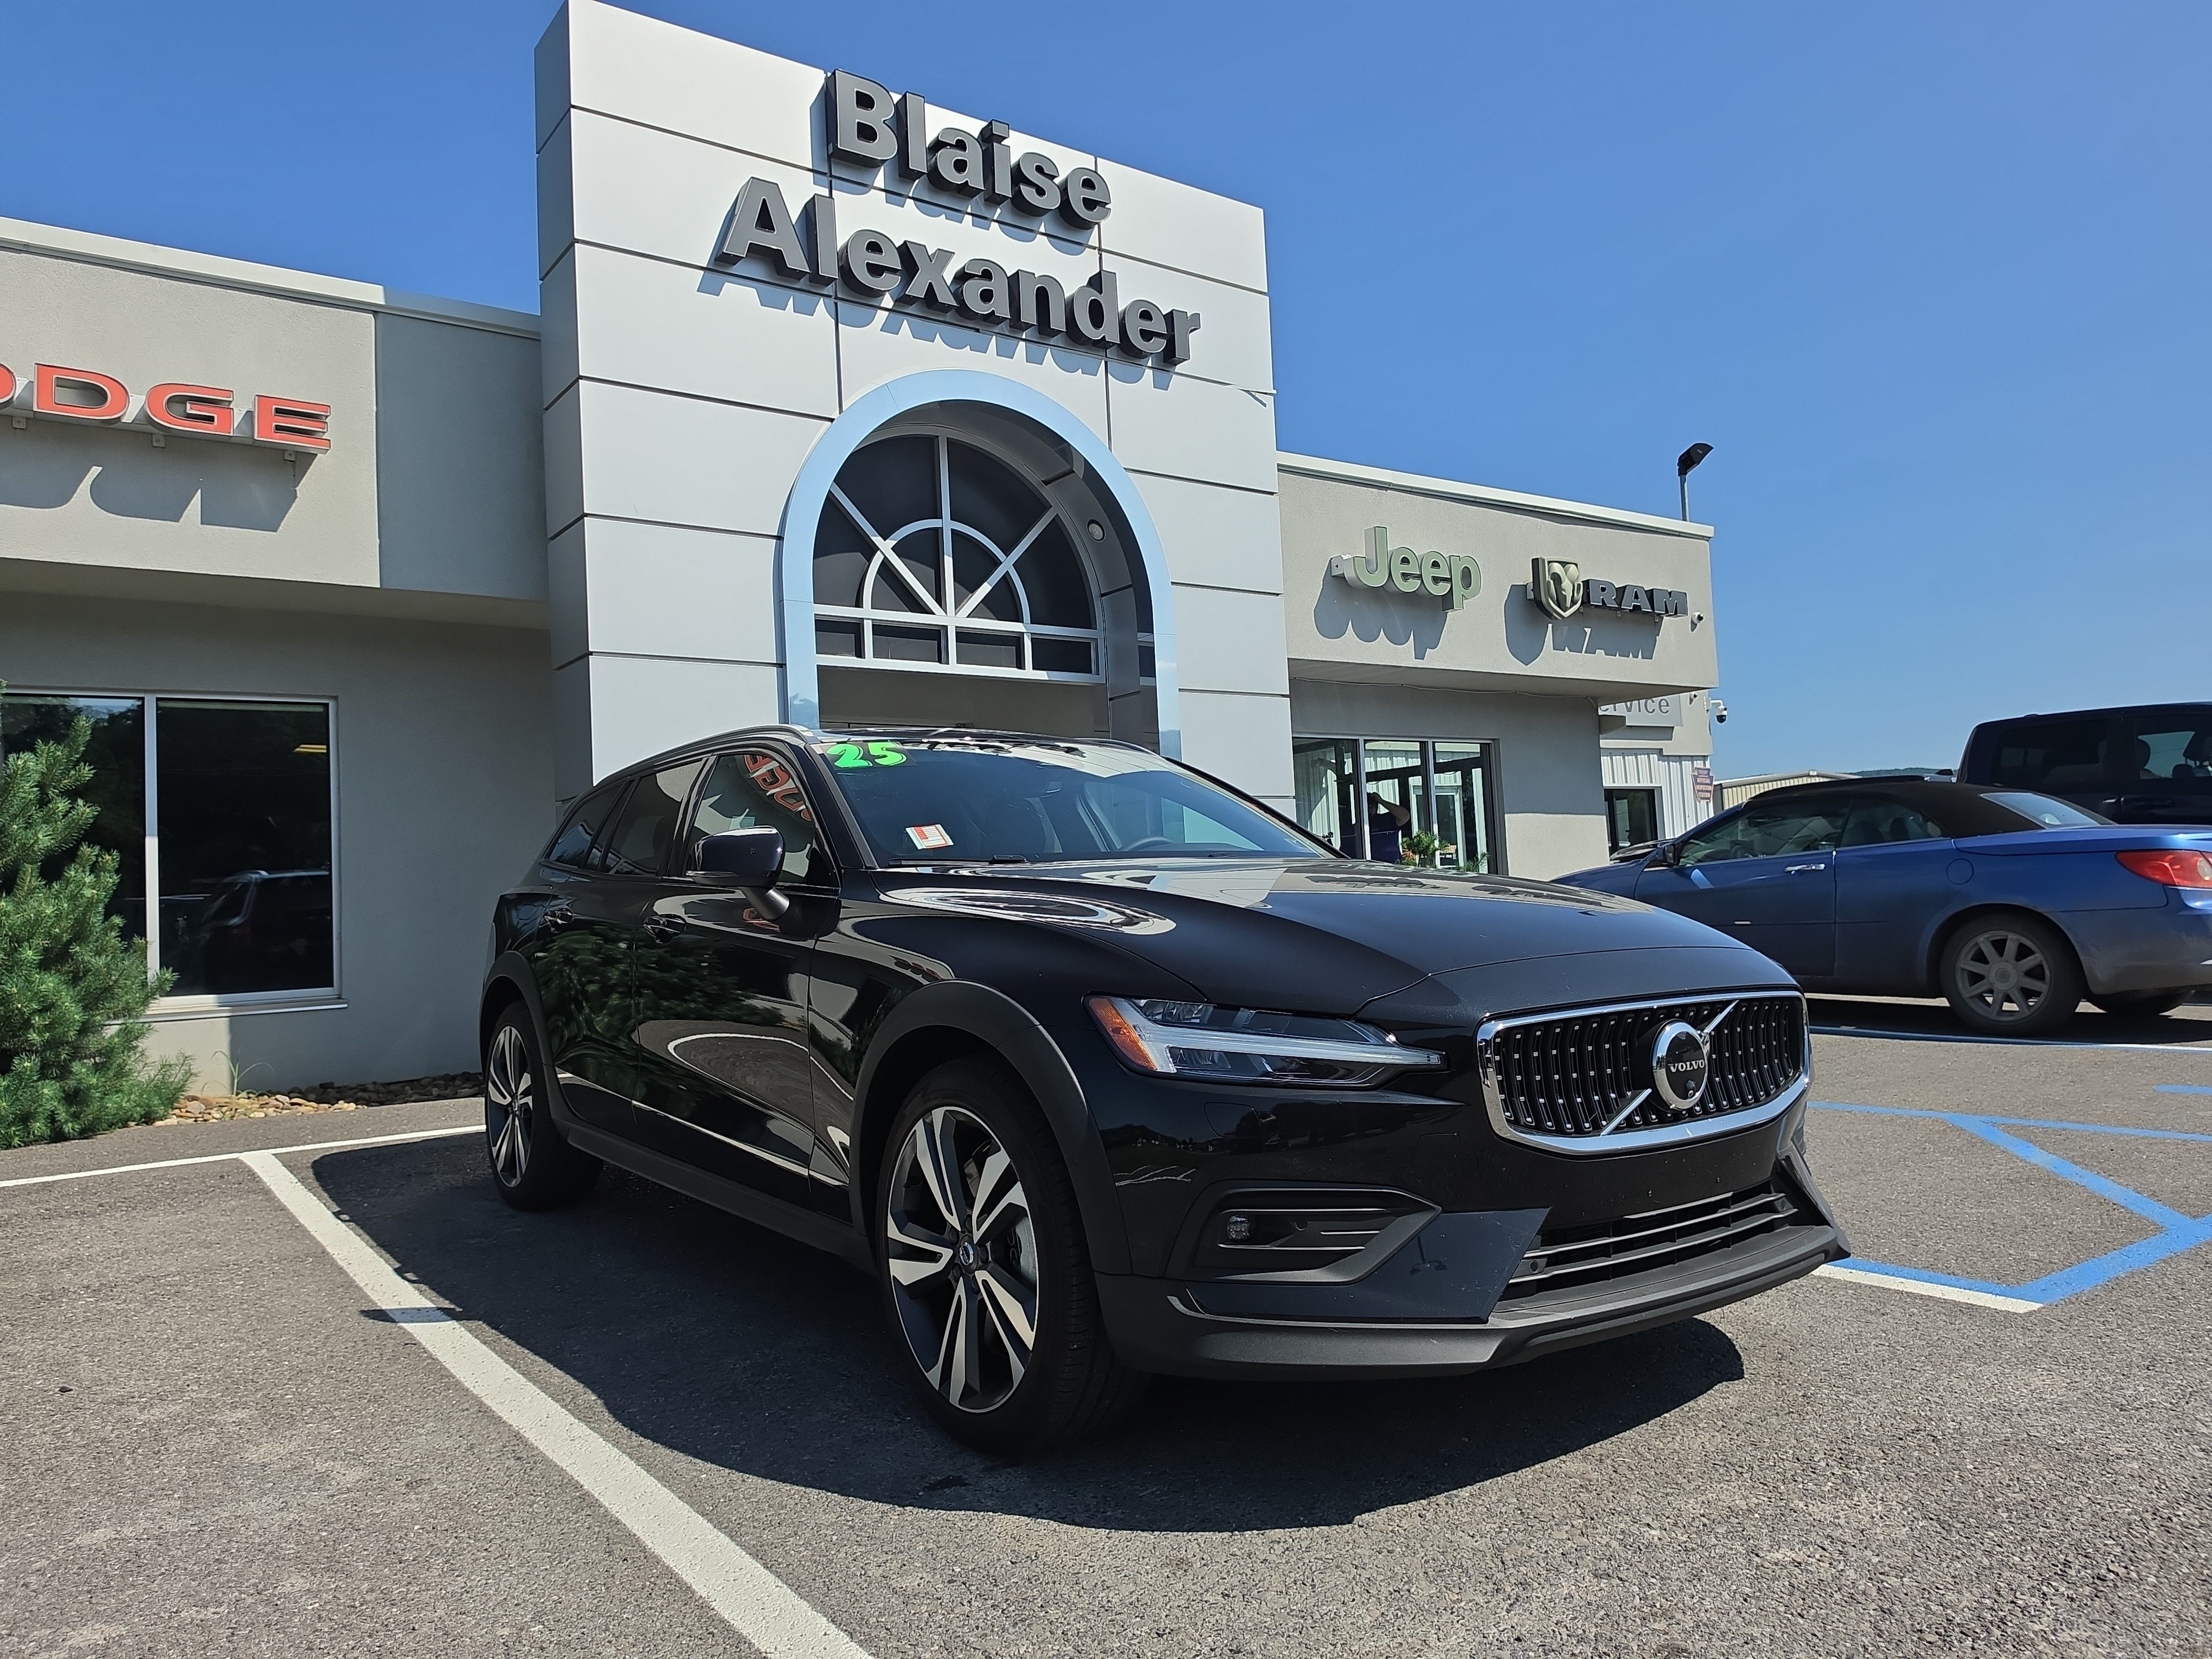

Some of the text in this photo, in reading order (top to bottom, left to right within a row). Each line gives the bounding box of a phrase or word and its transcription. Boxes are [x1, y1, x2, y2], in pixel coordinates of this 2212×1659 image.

[828, 69, 1112, 228] Blaise
[716, 177, 1200, 365] Alexander
[0, 362, 331, 453] DGE
[1346, 526, 1481, 611] Jeep
[1583, 578, 1688, 617] RAM
[826, 742, 907, 768] 25
[1668, 1059, 1705, 1073] VOLVO
